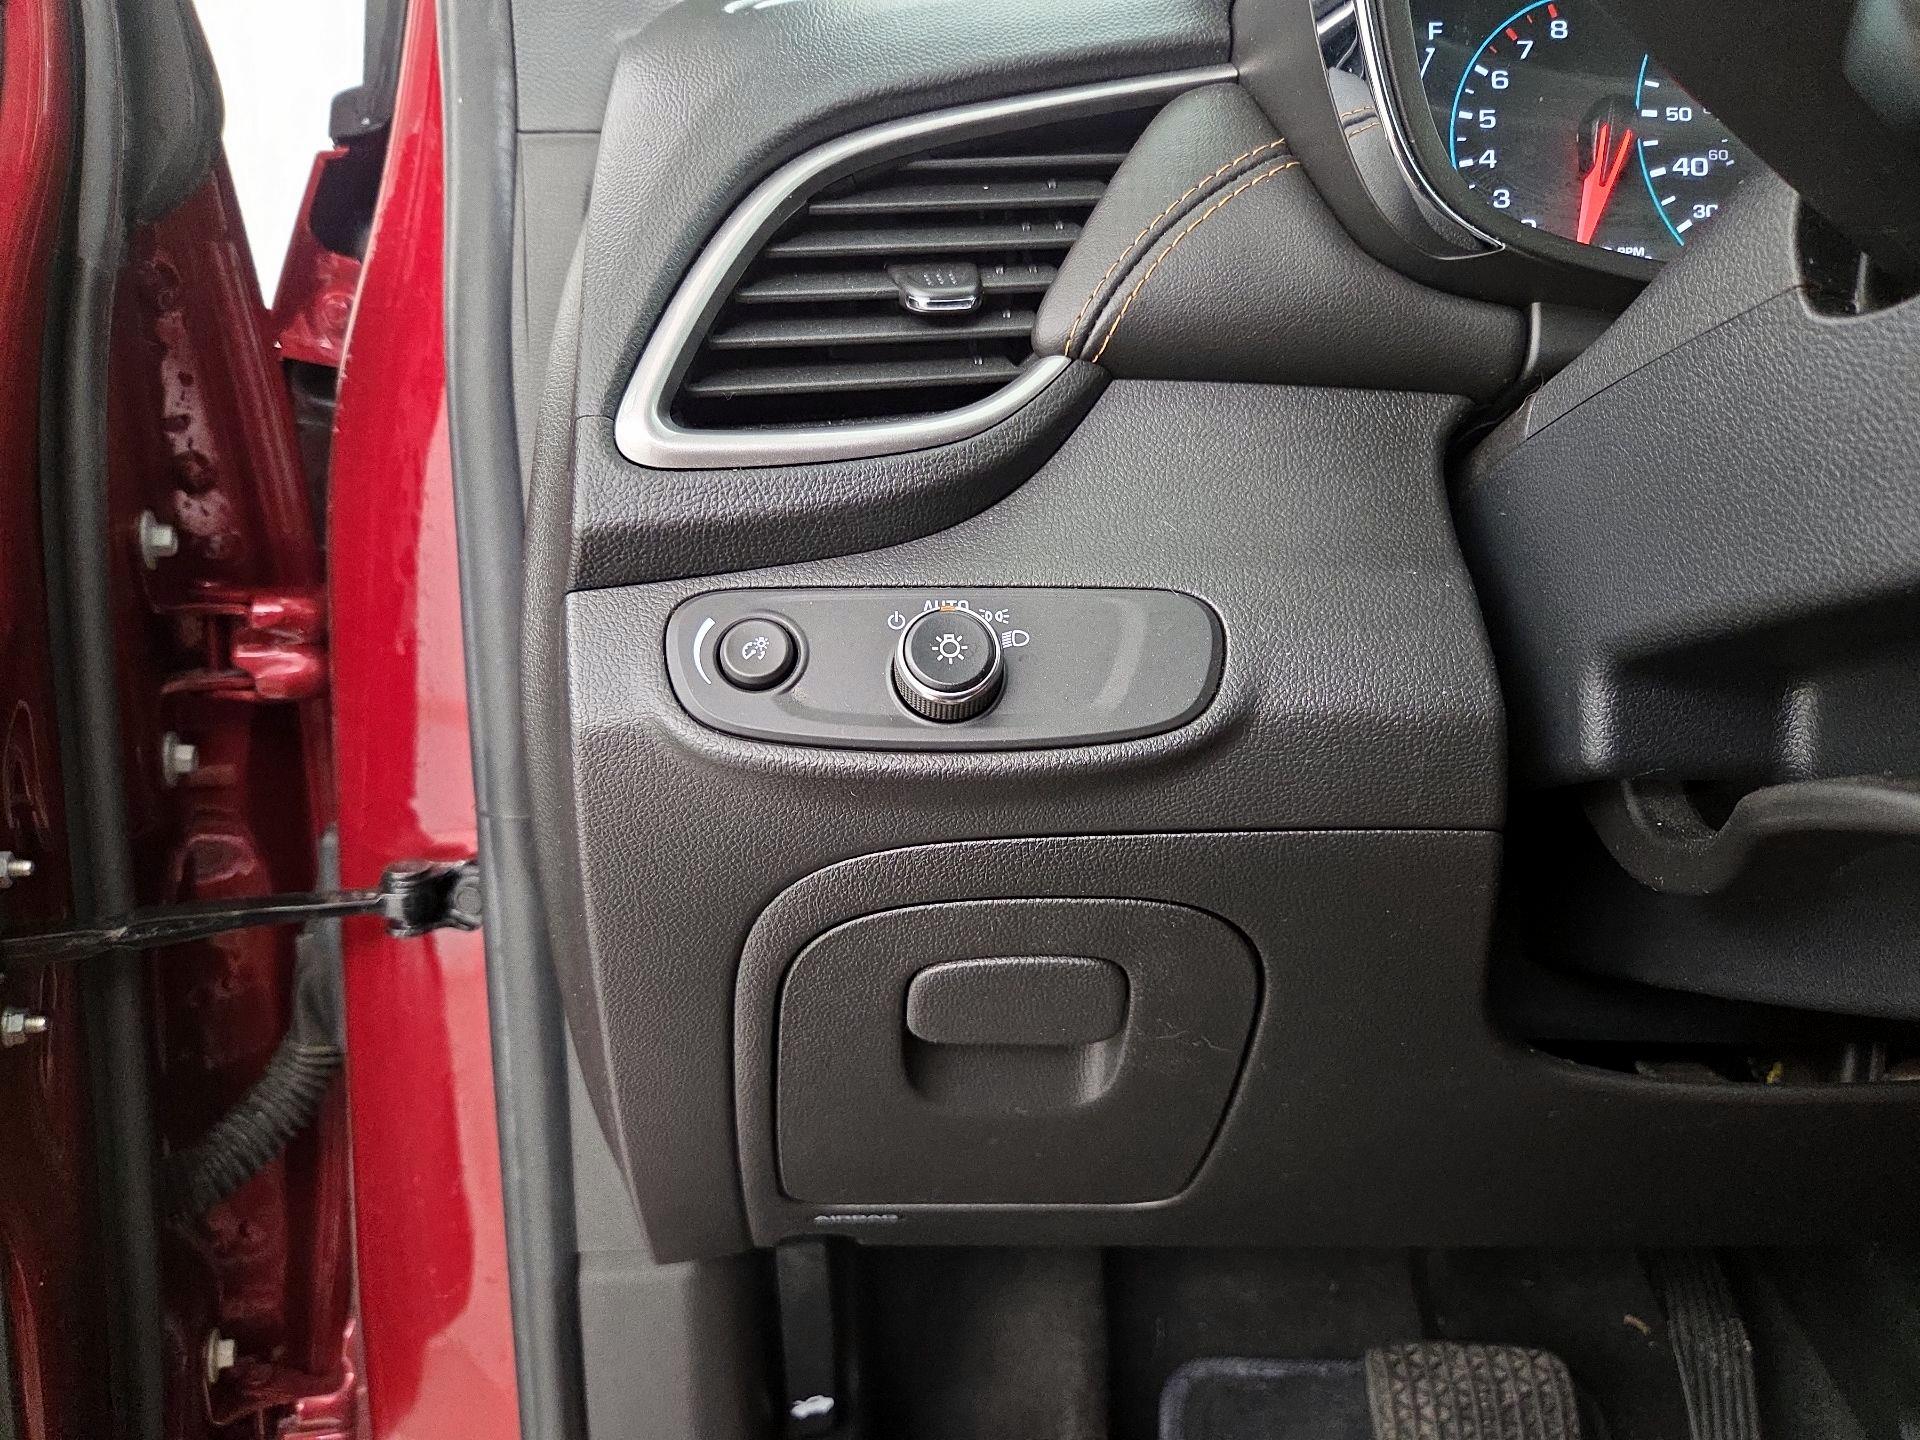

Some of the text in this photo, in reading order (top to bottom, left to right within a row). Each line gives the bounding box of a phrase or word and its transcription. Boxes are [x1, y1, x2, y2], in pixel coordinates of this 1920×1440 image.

[1428, 22, 1443, 40] F
[1550, 20, 1568, 39] 8
[1516, 40, 1534, 60] 7
[1491, 70, 1509, 89] 6
[1479, 109, 1497, 129] 5
[1665, 107, 1692, 122] 50
[1479, 149, 1497, 169] 4
[1708, 149, 1729, 161] 60
[1672, 157, 1709, 177] 40
[1492, 189, 1511, 209] 3
